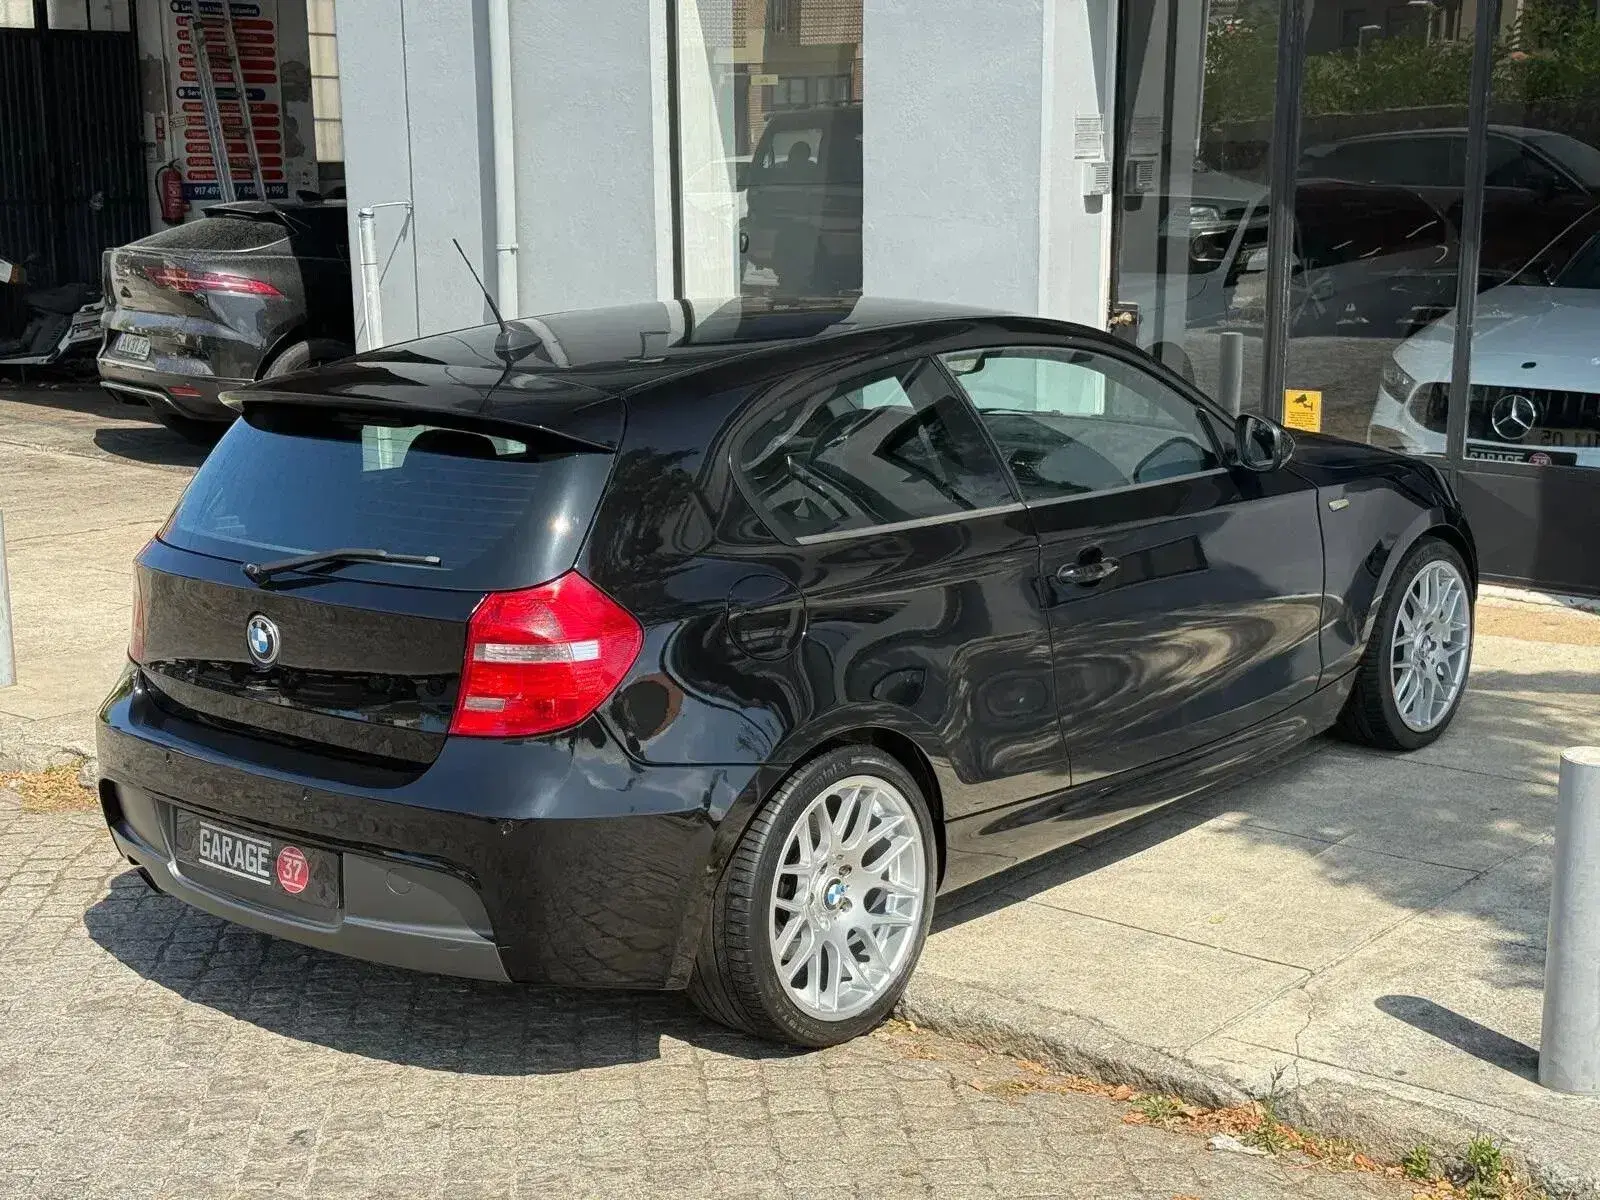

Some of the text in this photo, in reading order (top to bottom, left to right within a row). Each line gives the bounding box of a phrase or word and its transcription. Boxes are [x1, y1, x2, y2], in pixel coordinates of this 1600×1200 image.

[194, 186, 207, 195] 917
[271, 186, 284, 194] 990
[199, 828, 303, 882] GARAGE 37
